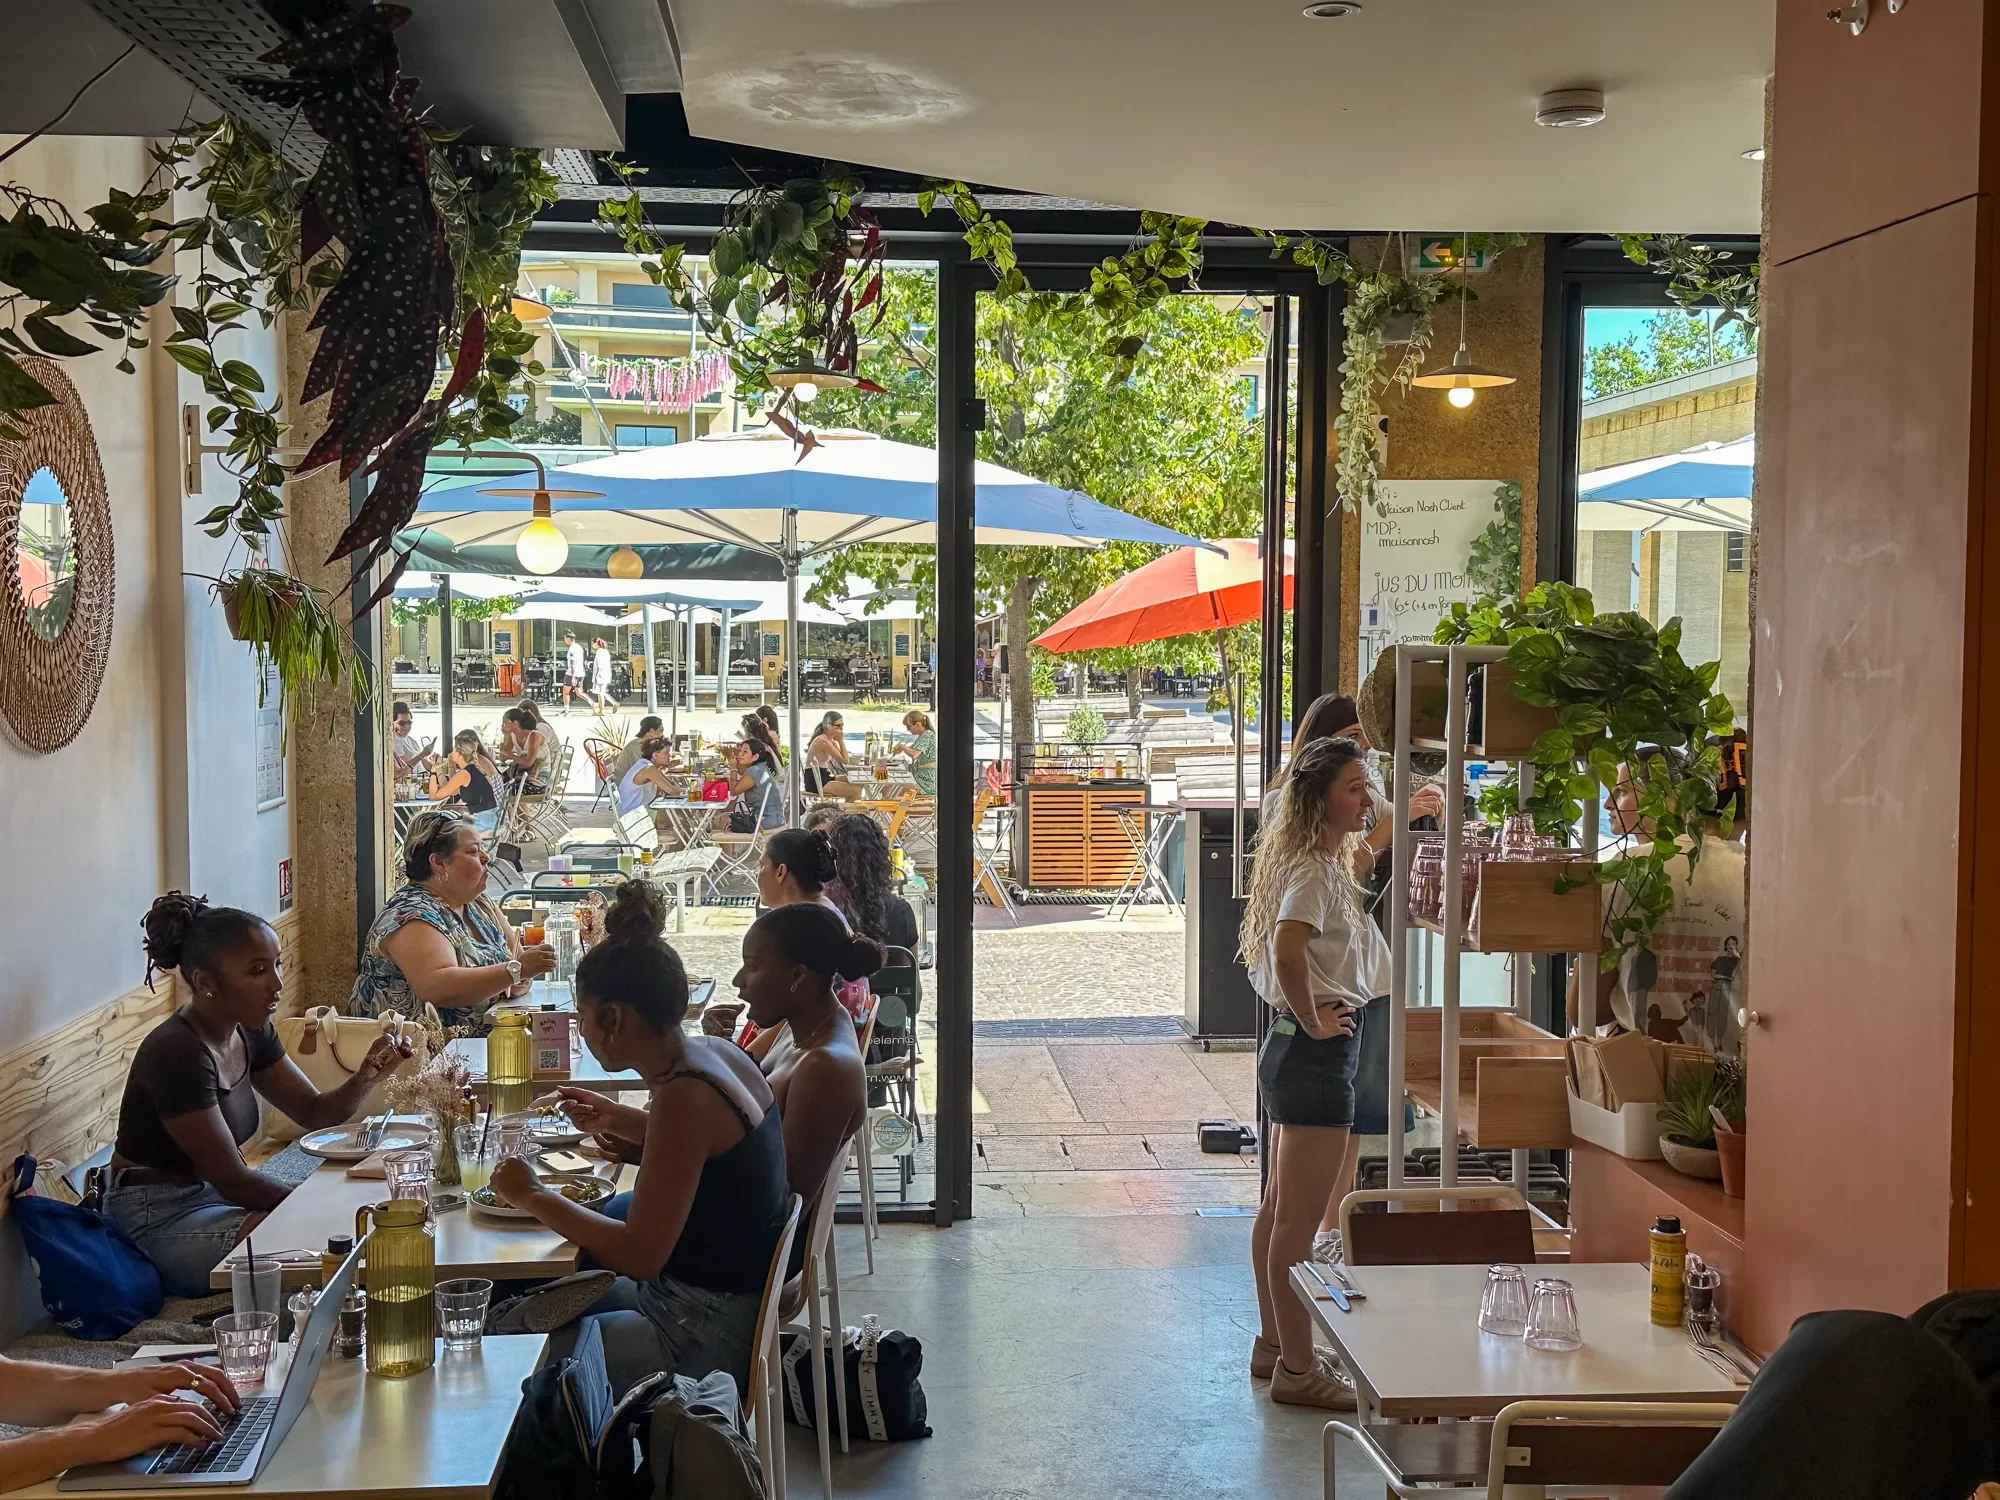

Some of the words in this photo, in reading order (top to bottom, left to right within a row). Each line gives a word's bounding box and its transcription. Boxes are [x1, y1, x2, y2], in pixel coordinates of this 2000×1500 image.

[1366, 521, 1402, 536] MDP:
[1405, 574, 1428, 593] DU
[864, 1386, 880, 1426] JIMMY
